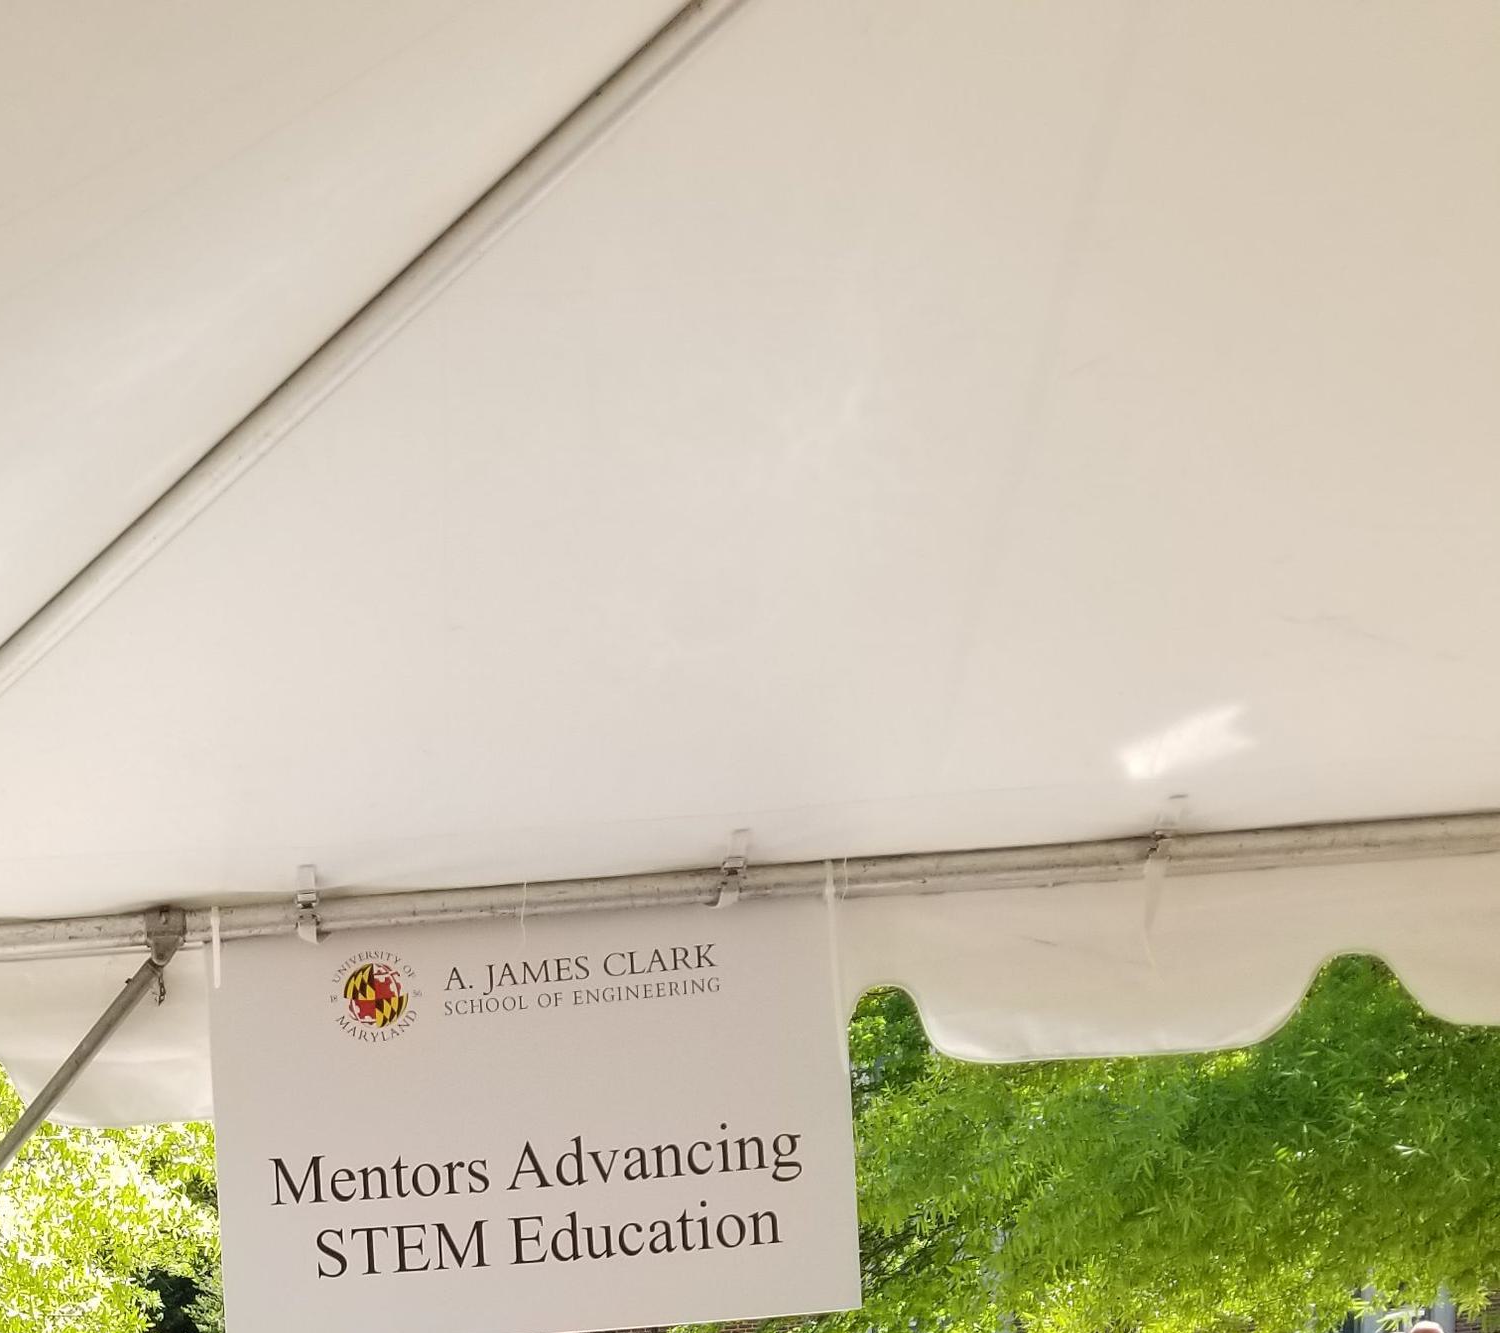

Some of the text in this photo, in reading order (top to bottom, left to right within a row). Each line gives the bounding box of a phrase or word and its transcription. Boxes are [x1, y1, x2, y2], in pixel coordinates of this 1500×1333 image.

[332, 950, 416, 984] UNIVERSITY OF
[443, 943, 718, 996] A. JAMES CLARK
[444, 976, 721, 1017] SCHOOL OF ENGINEERING
[336, 1009, 417, 1043] MARYLAND
[268, 1122, 803, 1206] Mentors Advancing
[316, 1200, 783, 1279] STEM Education
